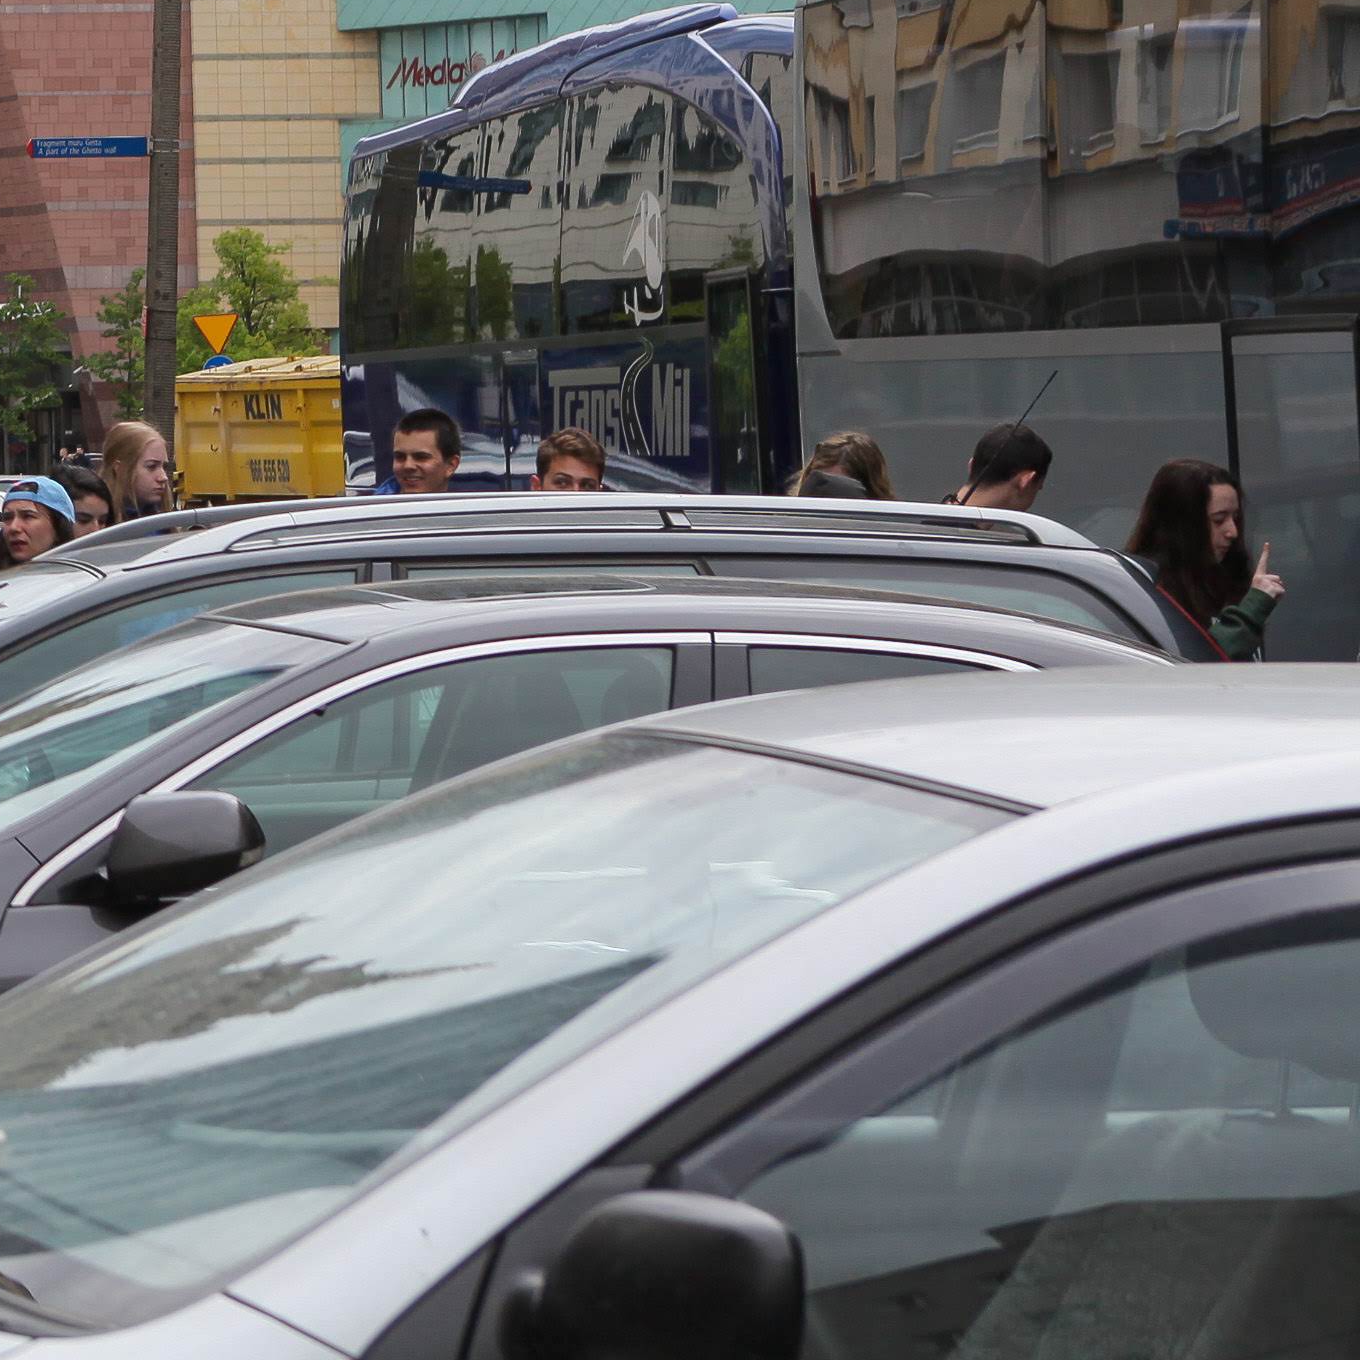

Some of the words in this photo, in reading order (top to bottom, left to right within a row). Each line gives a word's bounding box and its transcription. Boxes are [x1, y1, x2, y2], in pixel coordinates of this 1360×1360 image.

[386, 56, 465, 90] Media
[45, 147, 59, 157] part
[61, 146, 68, 155] of
[69, 146, 80, 155] the
[244, 393, 282, 419] KLIN
[548, 366, 621, 456] Trans
[652, 362, 690, 457] Mil
